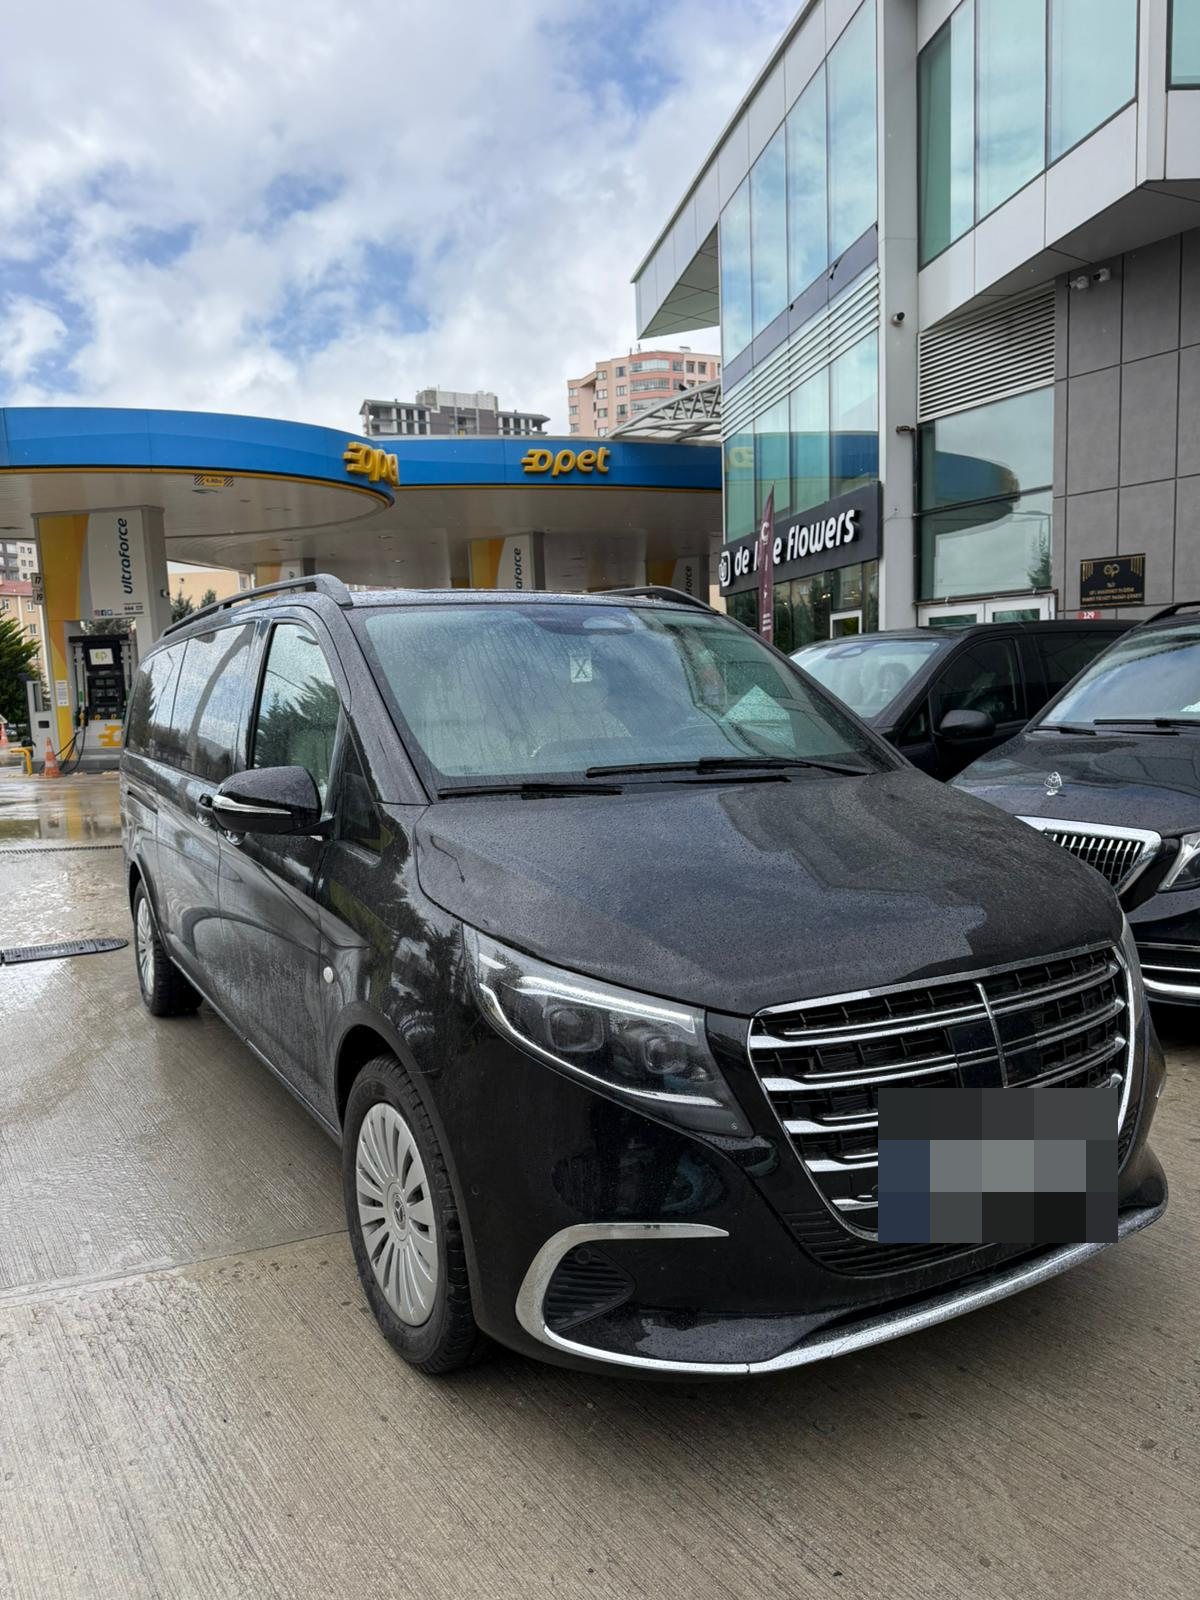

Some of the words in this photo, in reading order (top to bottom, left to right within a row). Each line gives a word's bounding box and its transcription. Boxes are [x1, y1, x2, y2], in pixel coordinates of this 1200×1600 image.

[342, 441, 399, 486] ope
[520, 446, 611, 477] opet
[117, 517, 134, 595] ultraforce
[734, 546, 750, 576] de
[753, 539, 782, 571] le
[786, 509, 856, 561] flowers
[513, 547, 523, 590] aforce
